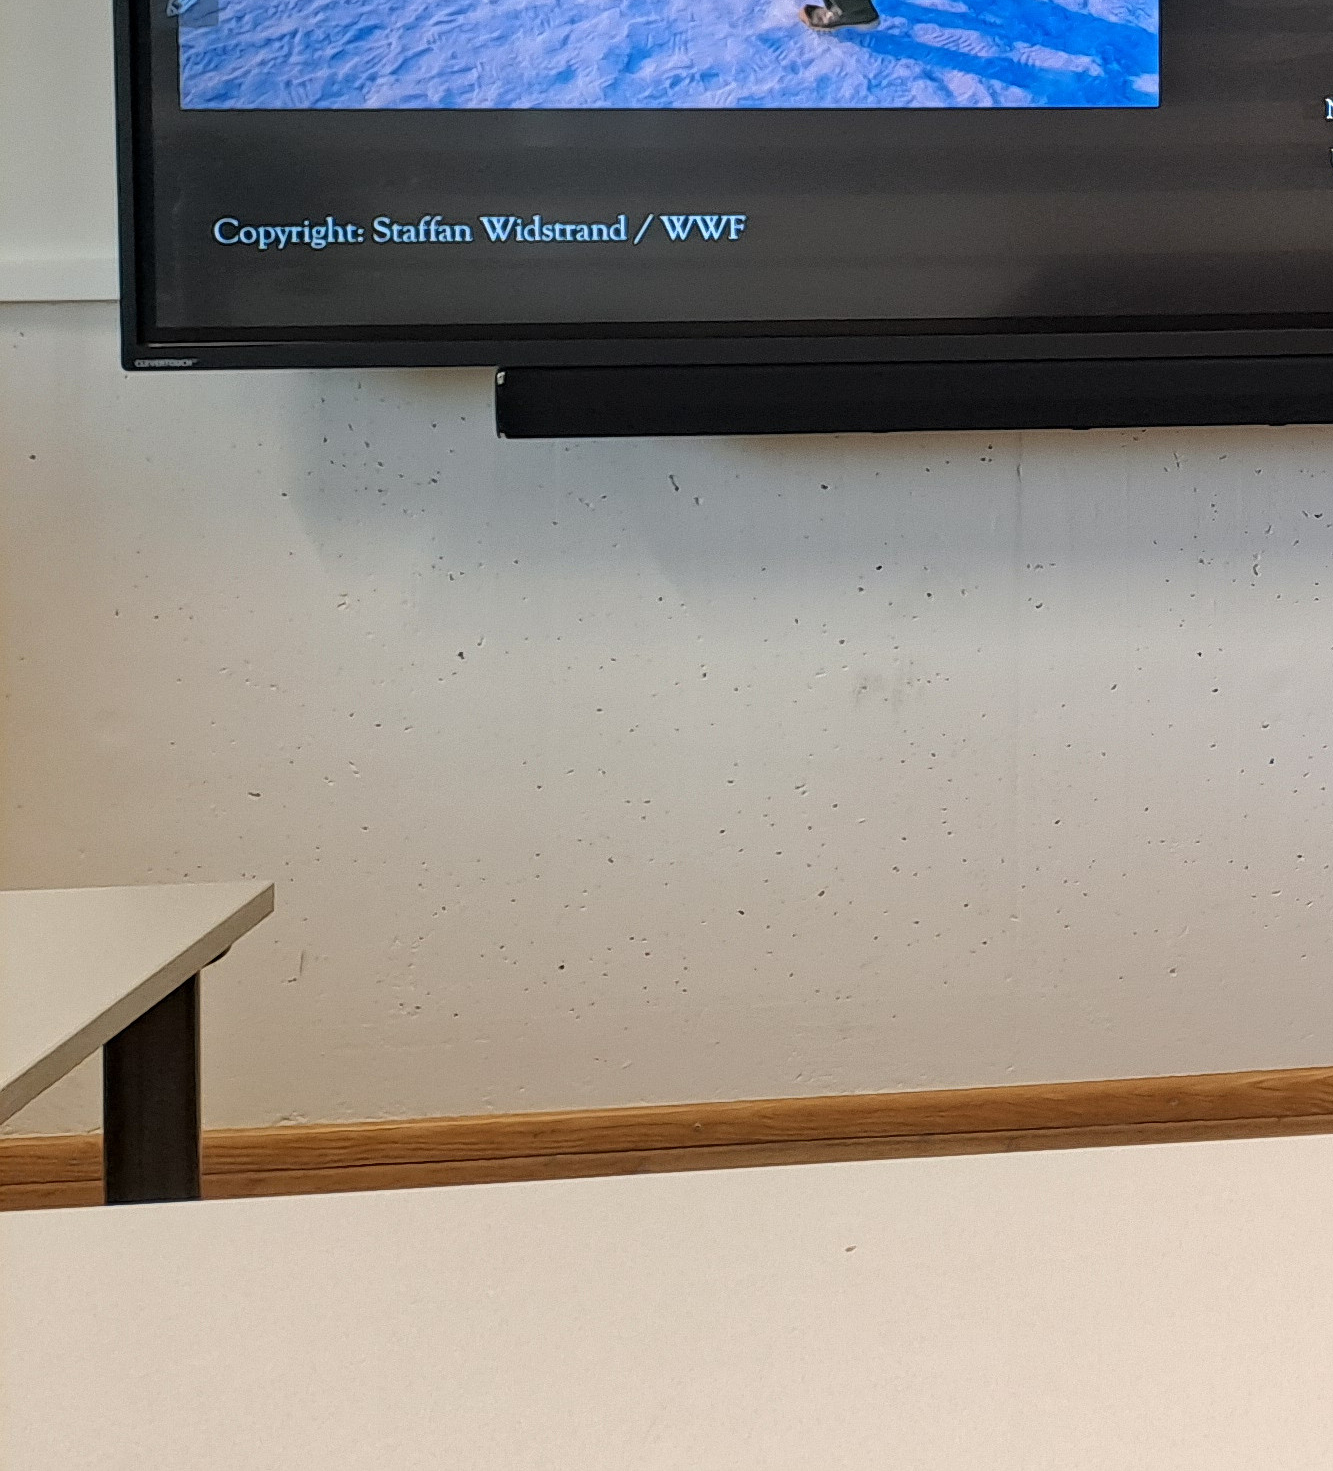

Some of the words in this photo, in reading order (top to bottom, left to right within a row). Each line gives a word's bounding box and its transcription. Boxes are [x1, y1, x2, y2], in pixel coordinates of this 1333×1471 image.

[213, 215, 364, 250] Copyright:
[373, 215, 473, 243] Staffan
[479, 214, 628, 243] Widstrand
[633, 214, 654, 244] /
[659, 214, 747, 241] WWF
